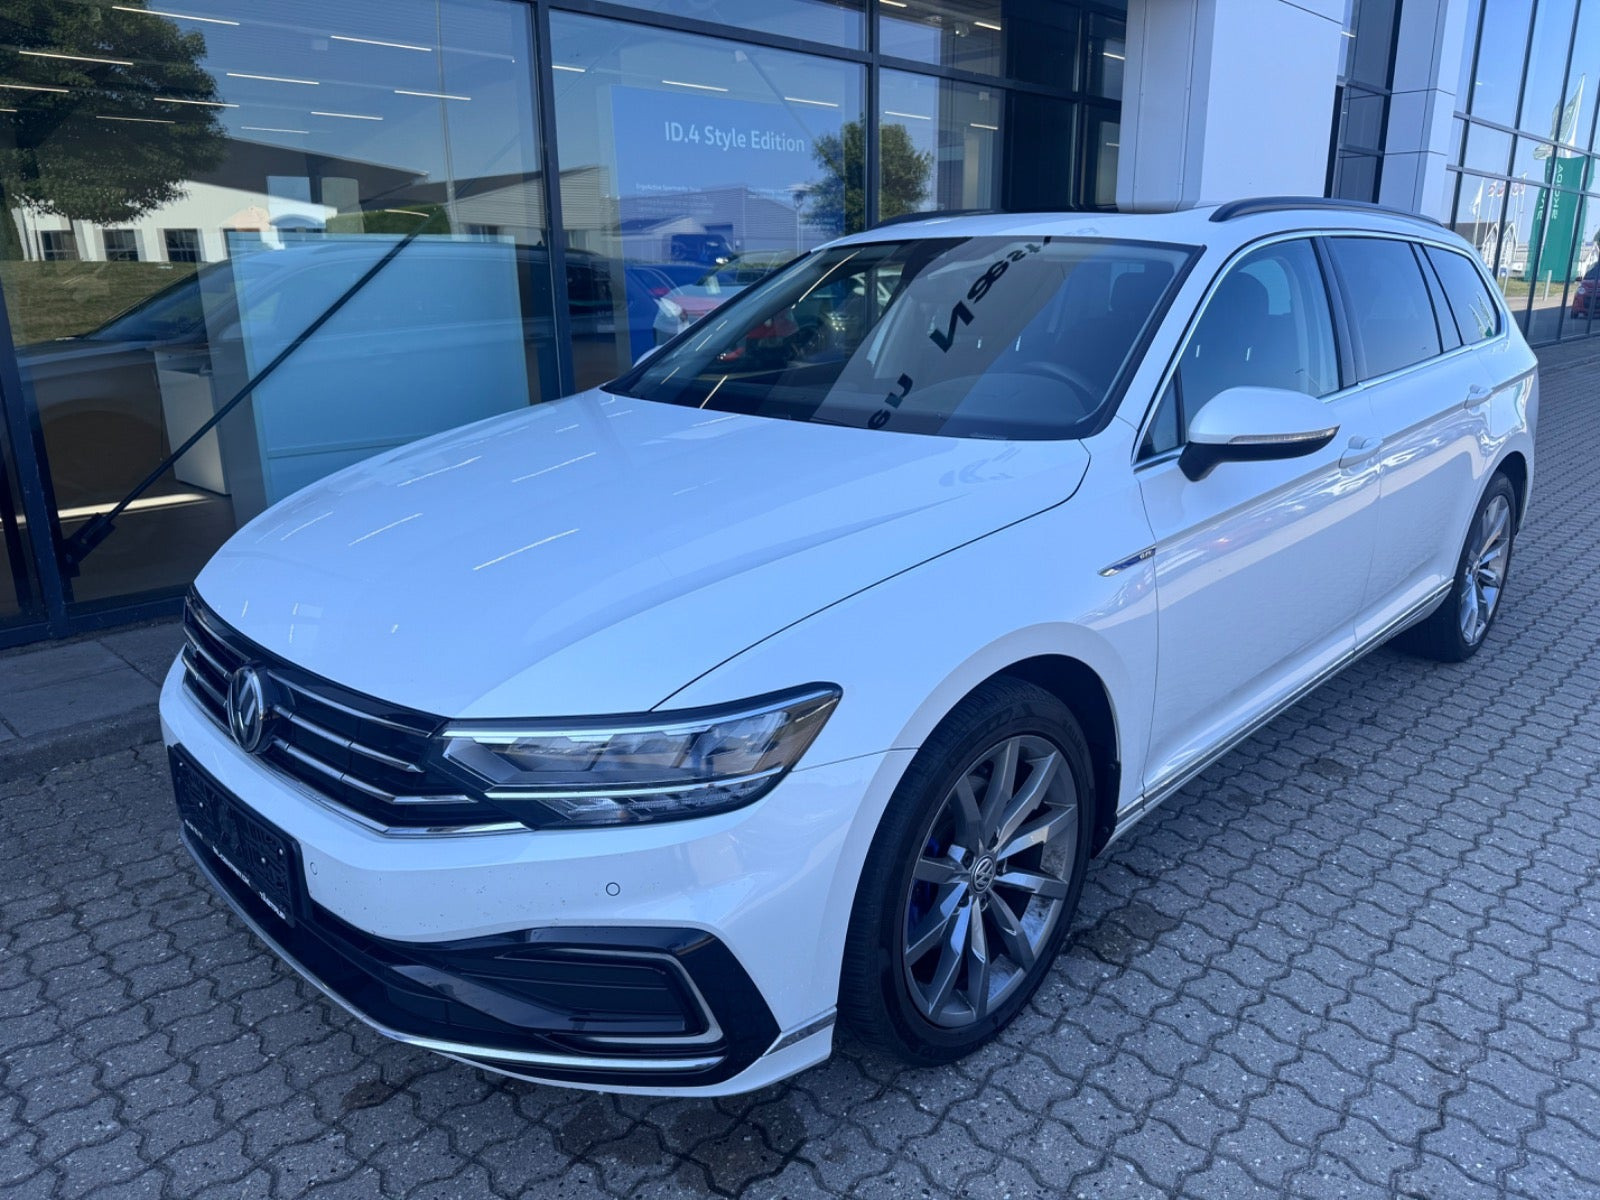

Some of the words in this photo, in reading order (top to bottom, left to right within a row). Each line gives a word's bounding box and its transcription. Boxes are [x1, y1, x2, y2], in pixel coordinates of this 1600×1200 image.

[664, 121, 700, 143] ID.4
[704, 125, 747, 152] Style
[751, 130, 805, 153] Edition
